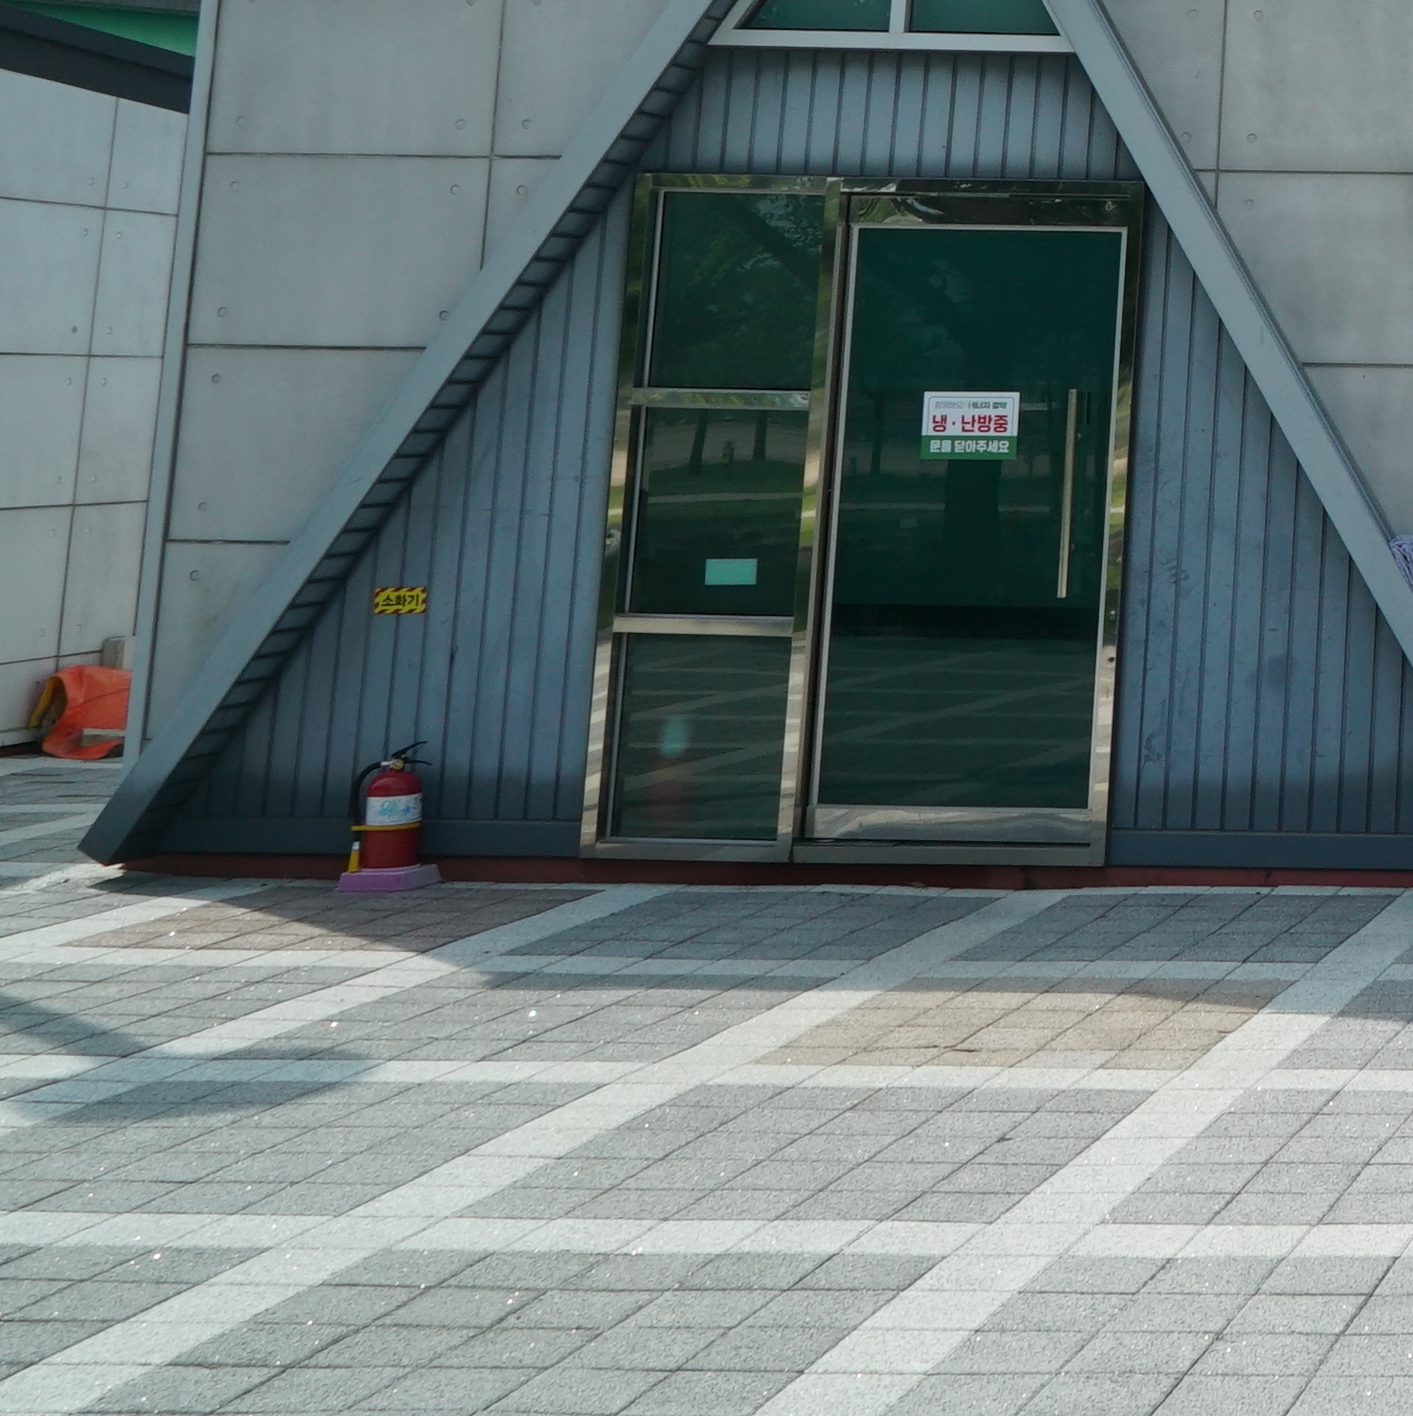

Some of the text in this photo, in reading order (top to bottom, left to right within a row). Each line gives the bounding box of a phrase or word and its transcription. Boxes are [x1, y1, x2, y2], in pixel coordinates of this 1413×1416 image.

[930, 439, 1010, 453] 문을 닫아주세요
[381, 594, 420, 607] 소화기
